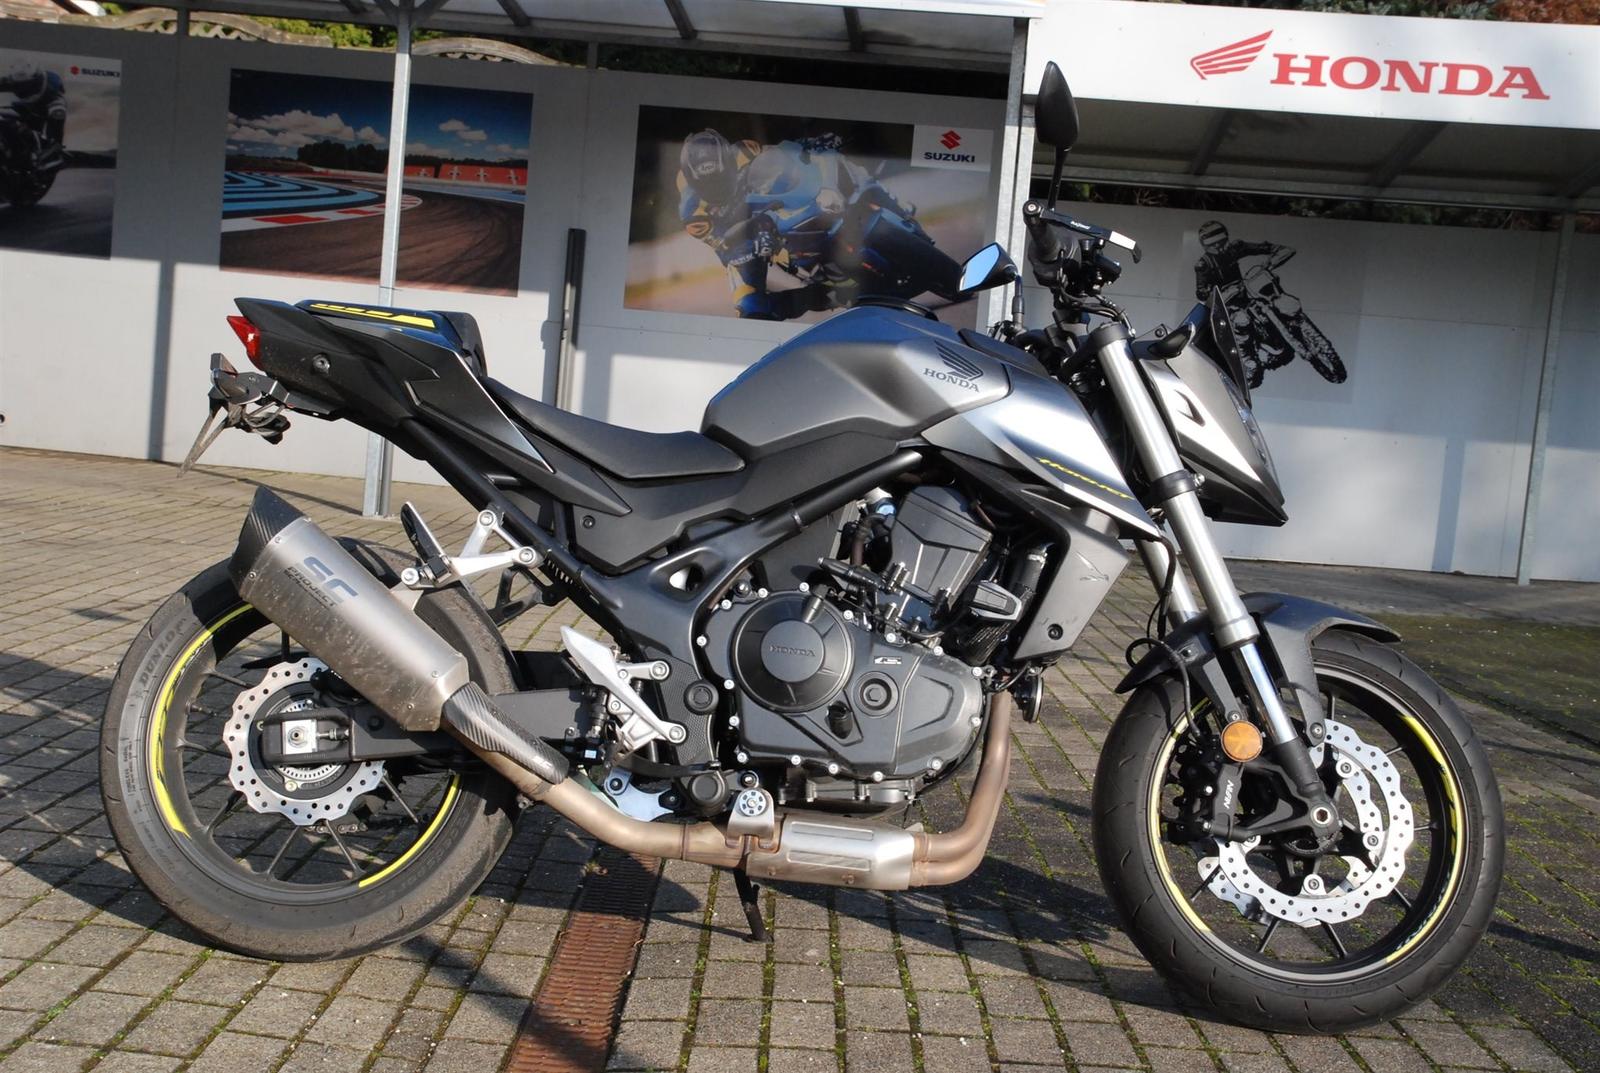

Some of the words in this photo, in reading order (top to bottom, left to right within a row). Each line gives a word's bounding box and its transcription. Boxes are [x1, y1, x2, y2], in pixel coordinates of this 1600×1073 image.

[81, 67, 120, 78] SUZUKI
[1270, 53, 1550, 100] HONDA
[924, 151, 976, 163] SUZUKI
[923, 367, 980, 393] HONDA
[769, 644, 816, 658] HONDA
